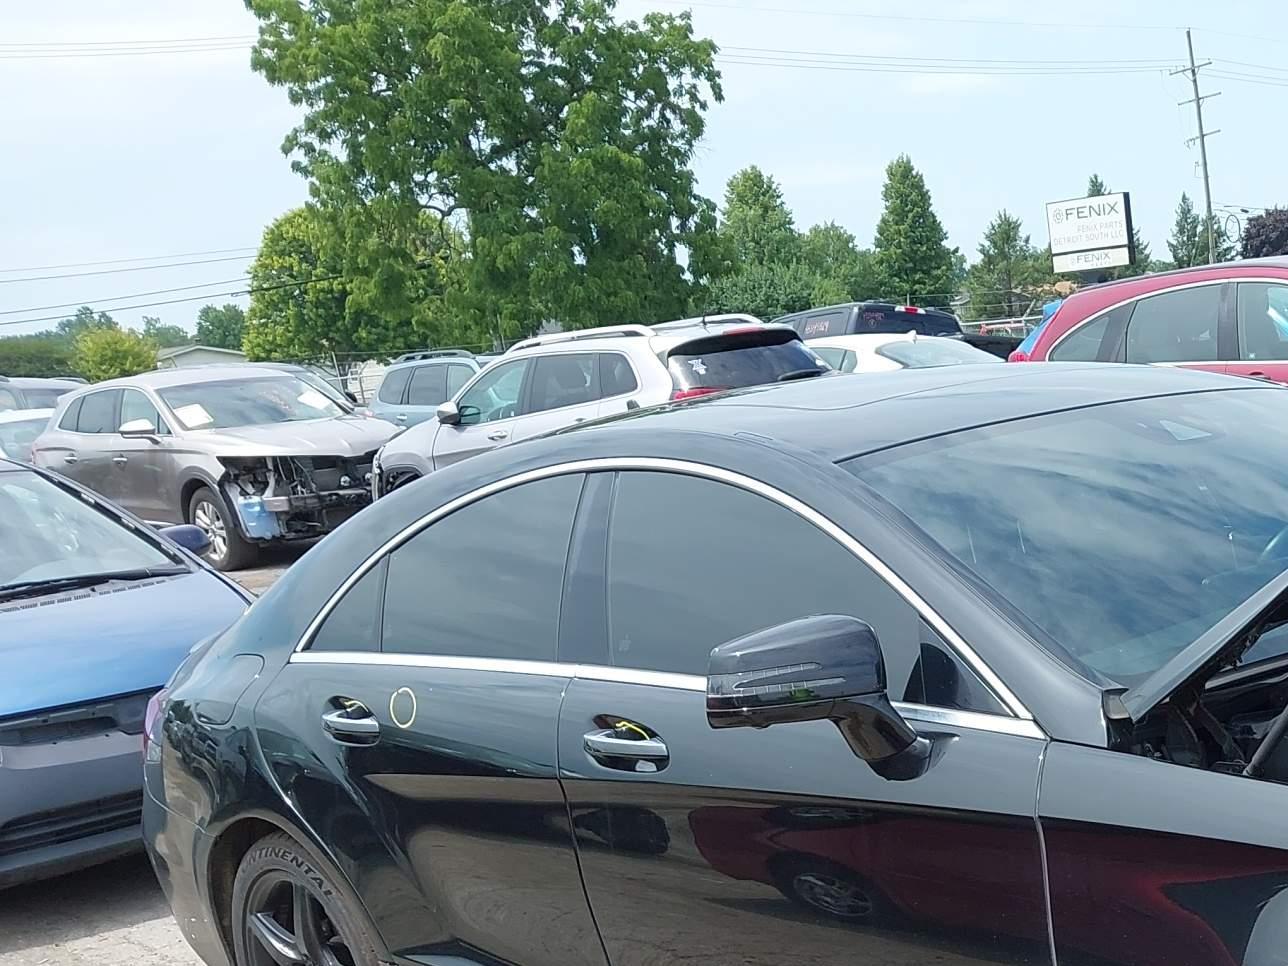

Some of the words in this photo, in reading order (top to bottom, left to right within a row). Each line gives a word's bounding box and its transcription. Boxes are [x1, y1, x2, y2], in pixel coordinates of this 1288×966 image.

[1065, 200, 1119, 221] FENIX
[1099, 219, 1123, 231] PARTS
[1085, 230, 1109, 242] SOUTH
[1111, 229, 1125, 239] LLC
[1076, 251, 1111, 264] FENIX
